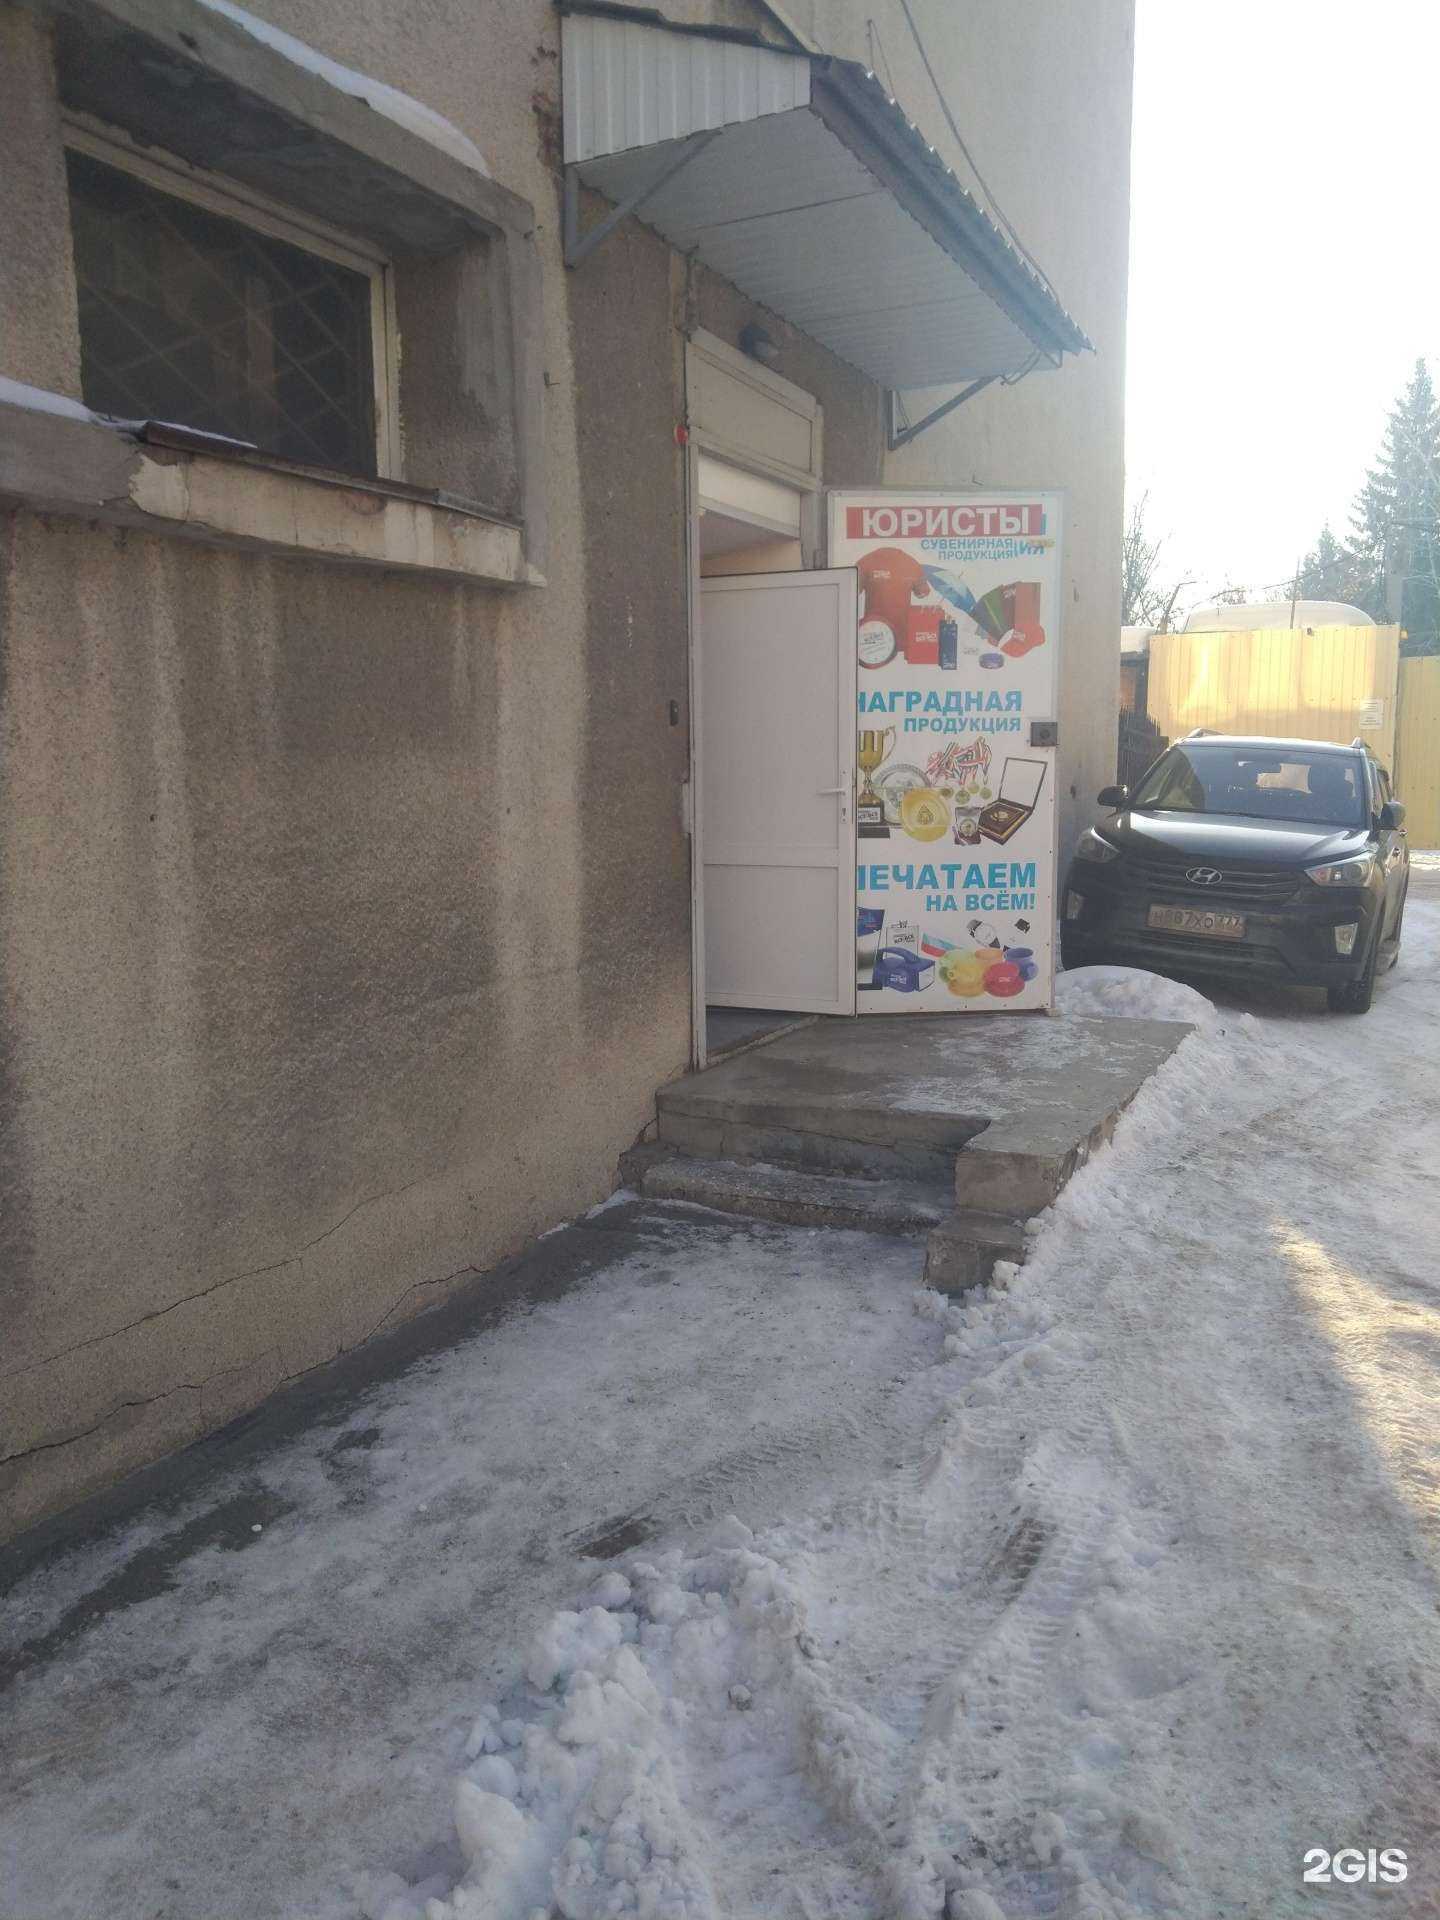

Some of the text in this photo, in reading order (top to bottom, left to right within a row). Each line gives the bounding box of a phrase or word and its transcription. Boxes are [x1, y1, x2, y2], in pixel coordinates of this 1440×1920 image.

[862, 506, 1030, 537] ЮРИСТЫ
[920, 537, 1013, 550] СУВЕНИРНАЯ
[938, 549, 1013, 561] ПРОДУКЦИЯ
[904, 717, 1021, 734] ПРОДУКЦИЯ
[926, 890, 1035, 912] НА ВСЁМ!
